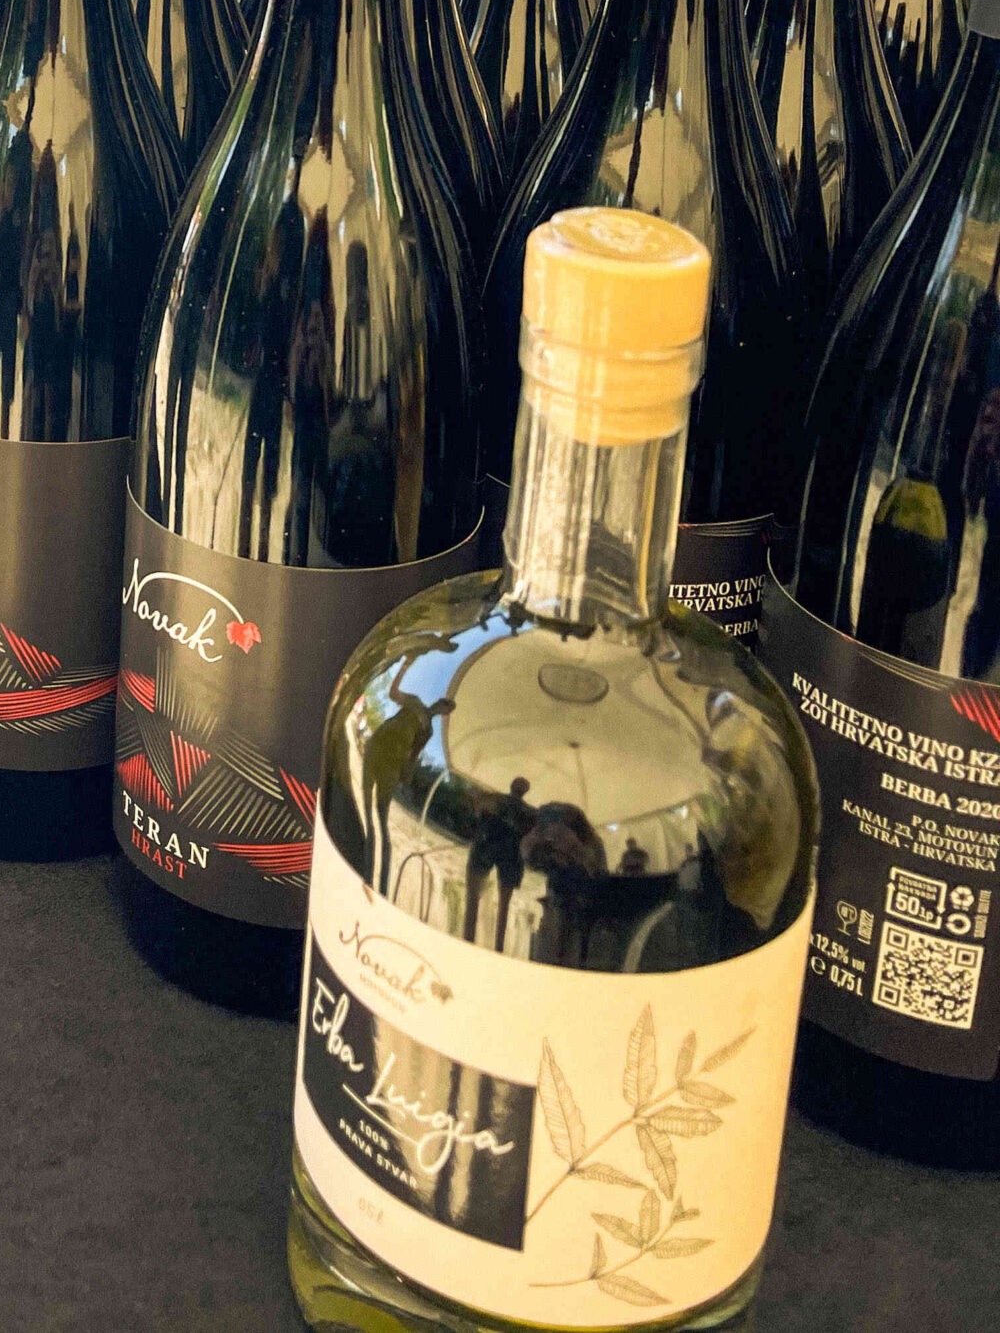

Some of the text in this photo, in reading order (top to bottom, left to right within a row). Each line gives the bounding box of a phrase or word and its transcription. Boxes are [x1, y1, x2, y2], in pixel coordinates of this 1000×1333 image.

[122, 557, 224, 663] Novak
[668, 582, 731, 598] ITETNO
[719, 618, 759, 637] ERBA
[792, 671, 1000, 769] KVALITETNO VINO KZ
[800, 695, 828, 725] ZOI
[830, 717, 939, 773] HRVATSKA
[880, 772, 953, 811] BERBA
[122, 789, 210, 870] TERAN
[131, 826, 188, 880] HRAST
[841, 798, 892, 831] KANAL
[918, 829, 999, 860] MOTOVUN
[859, 820, 901, 849] ISTRA
[912, 841, 997, 873] HRVATSKA
[944, 823, 1000, 847] NOVAK
[338, 919, 428, 1004] Novak
[339, 1118, 417, 1190] PRAVA STVAR
[359, 1119, 390, 1152] 100%
